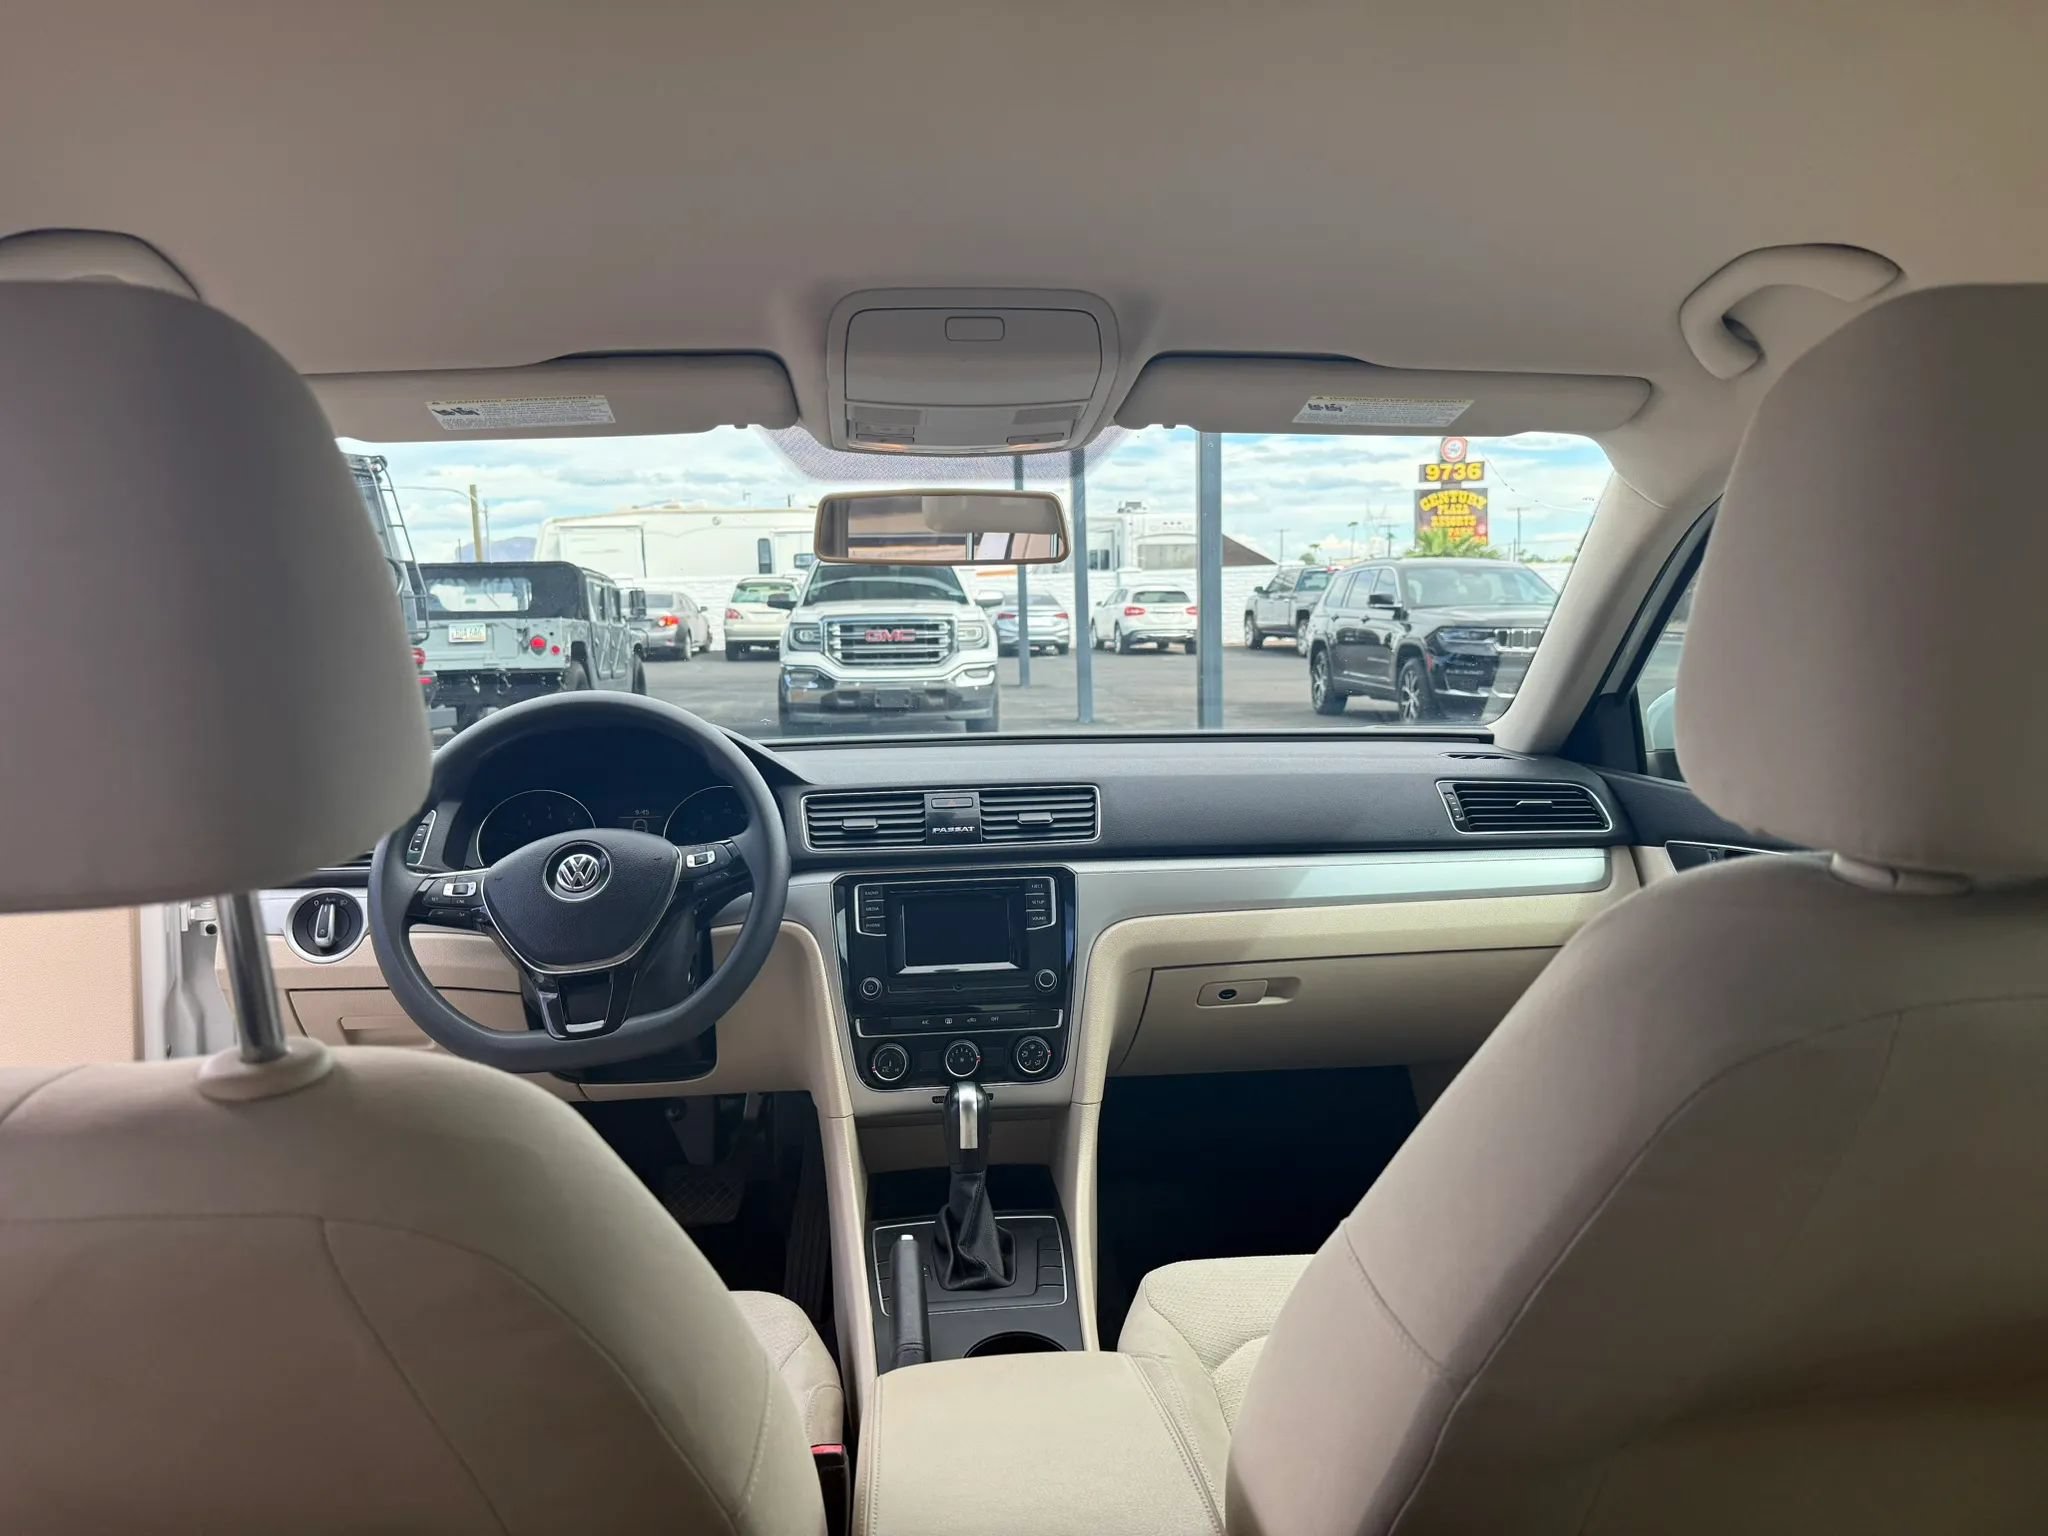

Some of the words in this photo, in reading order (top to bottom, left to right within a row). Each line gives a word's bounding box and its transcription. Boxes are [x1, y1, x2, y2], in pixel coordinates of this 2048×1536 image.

[1425, 463, 1482, 481] 9736
[1420, 489, 1487, 511] CENTURY
[864, 629, 916, 642] GMC
